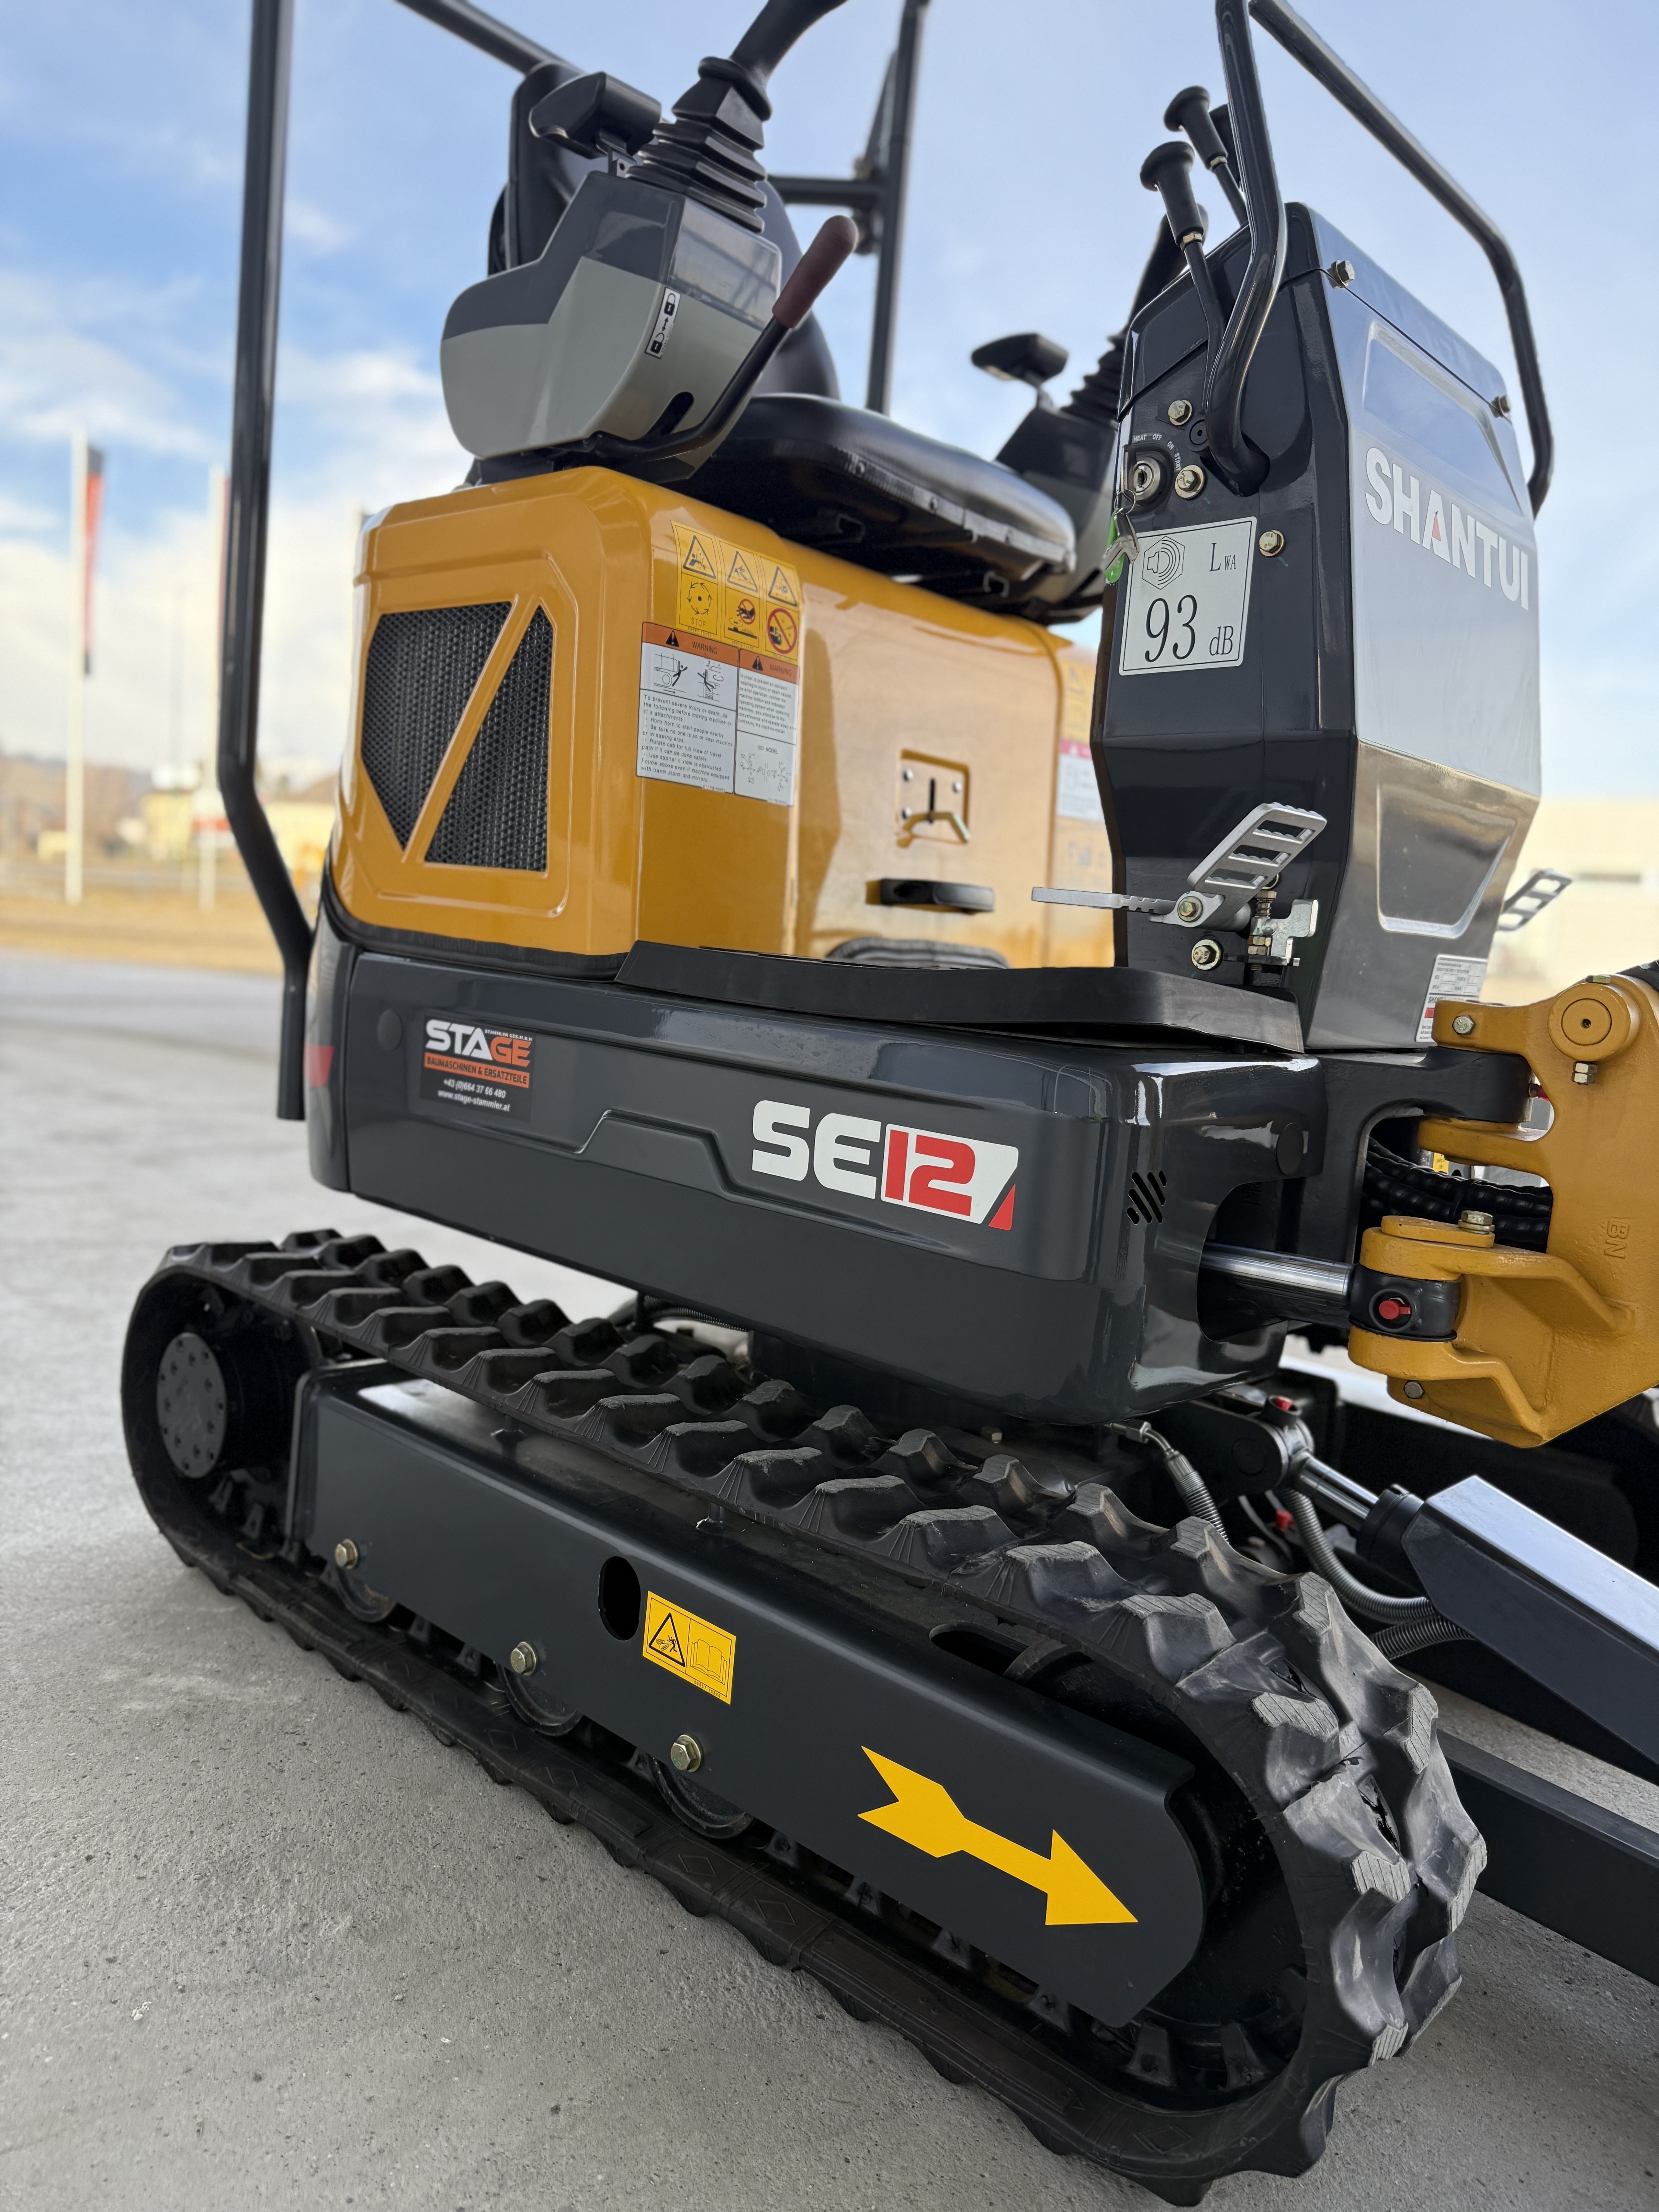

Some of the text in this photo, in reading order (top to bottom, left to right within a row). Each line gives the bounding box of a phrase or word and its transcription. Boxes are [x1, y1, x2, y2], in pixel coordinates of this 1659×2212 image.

[1133, 434, 1147, 442] HEAT
[1167, 441, 1175, 450] ON
[1365, 447, 1528, 611] SHANTUI
[691, 618, 706, 627] STOP
[1144, 594, 1233, 663] 93 dB
[692, 641, 718, 654] WARNING
[770, 663, 792, 676] WARNING
[653, 696, 670, 705] prevent
[654, 703, 674, 714] following
[692, 713, 707, 721] moving
[694, 727, 708, 735] people
[711, 773, 729, 781] equipped
[485, 1029, 508, 1037] STAMMLER
[425, 1019, 531, 1067] STAGE
[427, 1056, 527, 1085] BAUMASCHINEN & ERSATZTEILE
[444, 1079, 506, 1098] +43 (0)664 37 66 480
[437, 1089, 510, 1112] www.stage-stammler.at
[752, 1100, 976, 1217] SE12
[1604, 1220, 1630, 1259] BN
